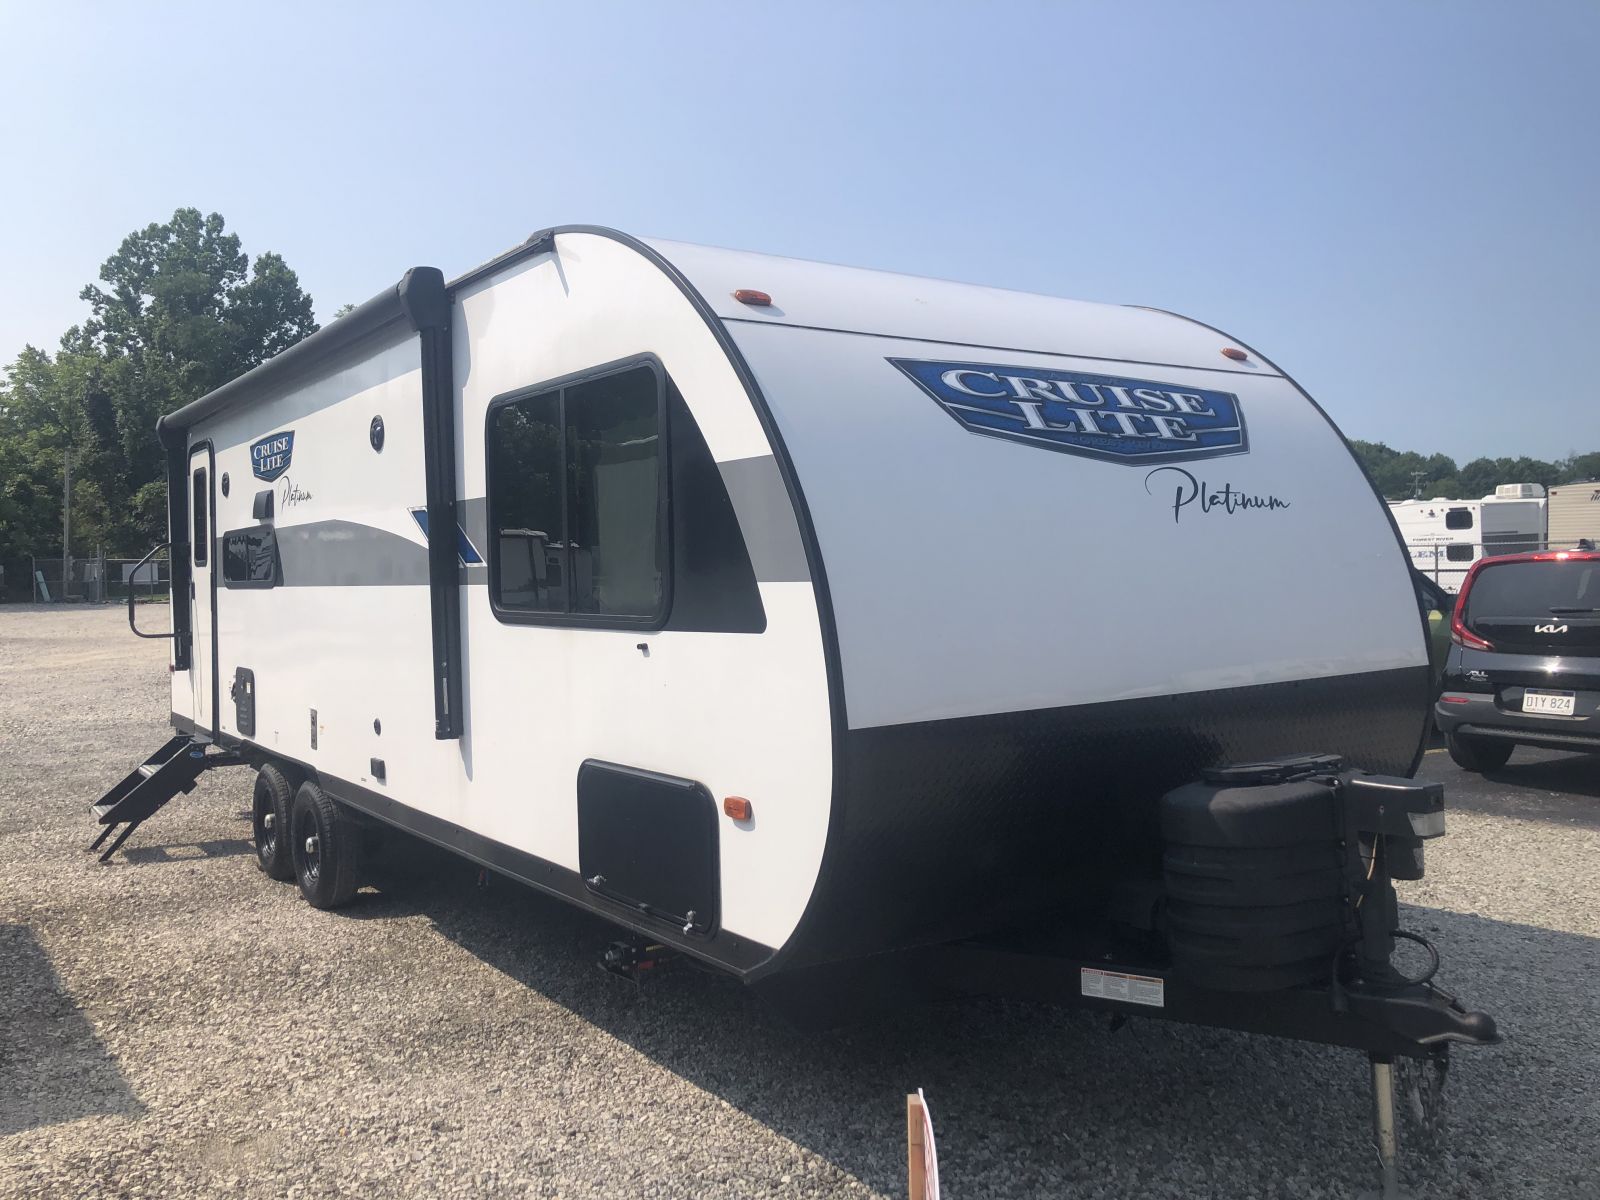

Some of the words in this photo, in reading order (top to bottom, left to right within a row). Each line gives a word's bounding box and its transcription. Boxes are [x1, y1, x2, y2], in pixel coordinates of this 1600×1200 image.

[941, 370, 1216, 417] CRUISE
[1009, 400, 1198, 442] LITE
[253, 437, 289, 460] CRUISE
[260, 454, 283, 472] LITE
[1145, 466, 1291, 524] Platinum
[1534, 624, 1568, 634] KIA
[1550, 698, 1571, 709] 824
